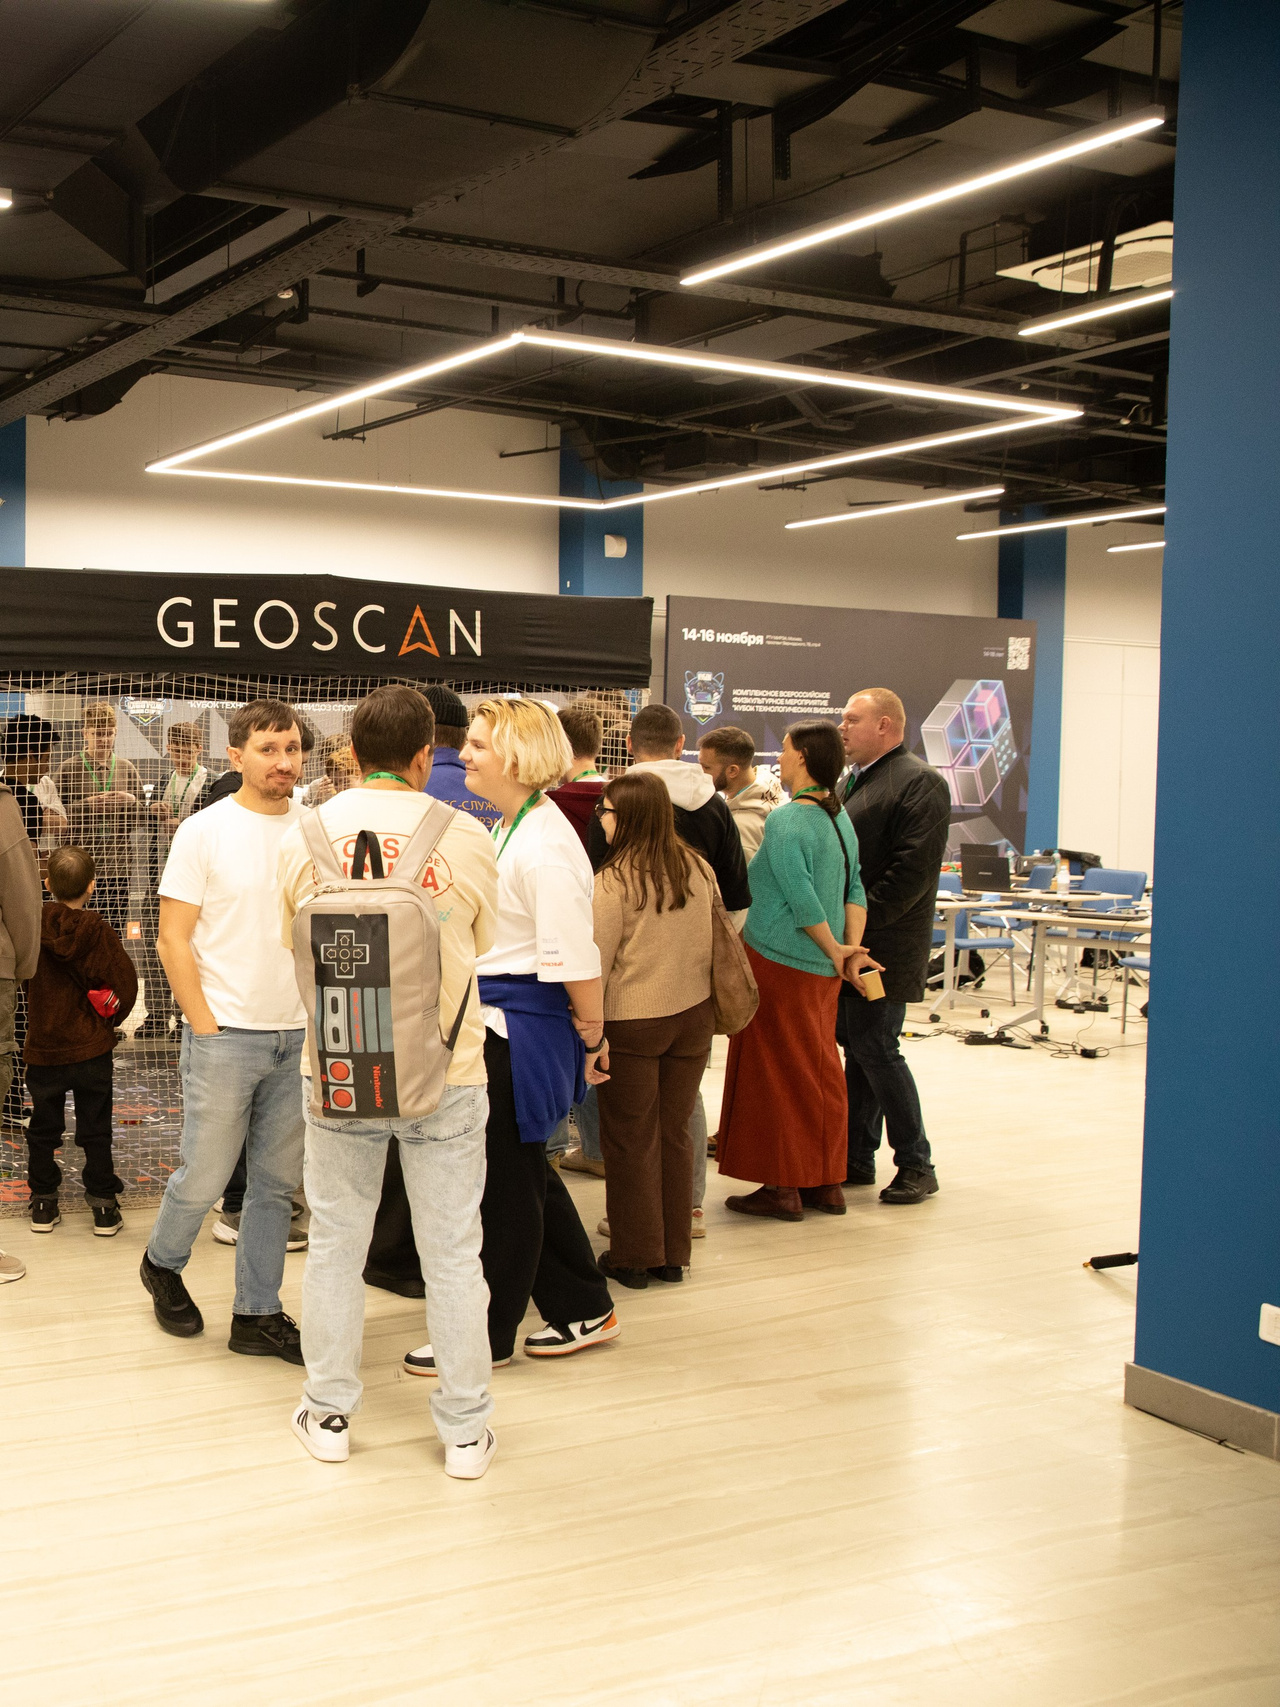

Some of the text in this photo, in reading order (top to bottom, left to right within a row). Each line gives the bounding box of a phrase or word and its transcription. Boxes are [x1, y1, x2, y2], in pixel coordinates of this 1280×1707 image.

[156, 596, 481, 658] GEOSCAN
[716, 631, 764, 646] ноября
[372, 1065, 383, 1108] Nintendo
